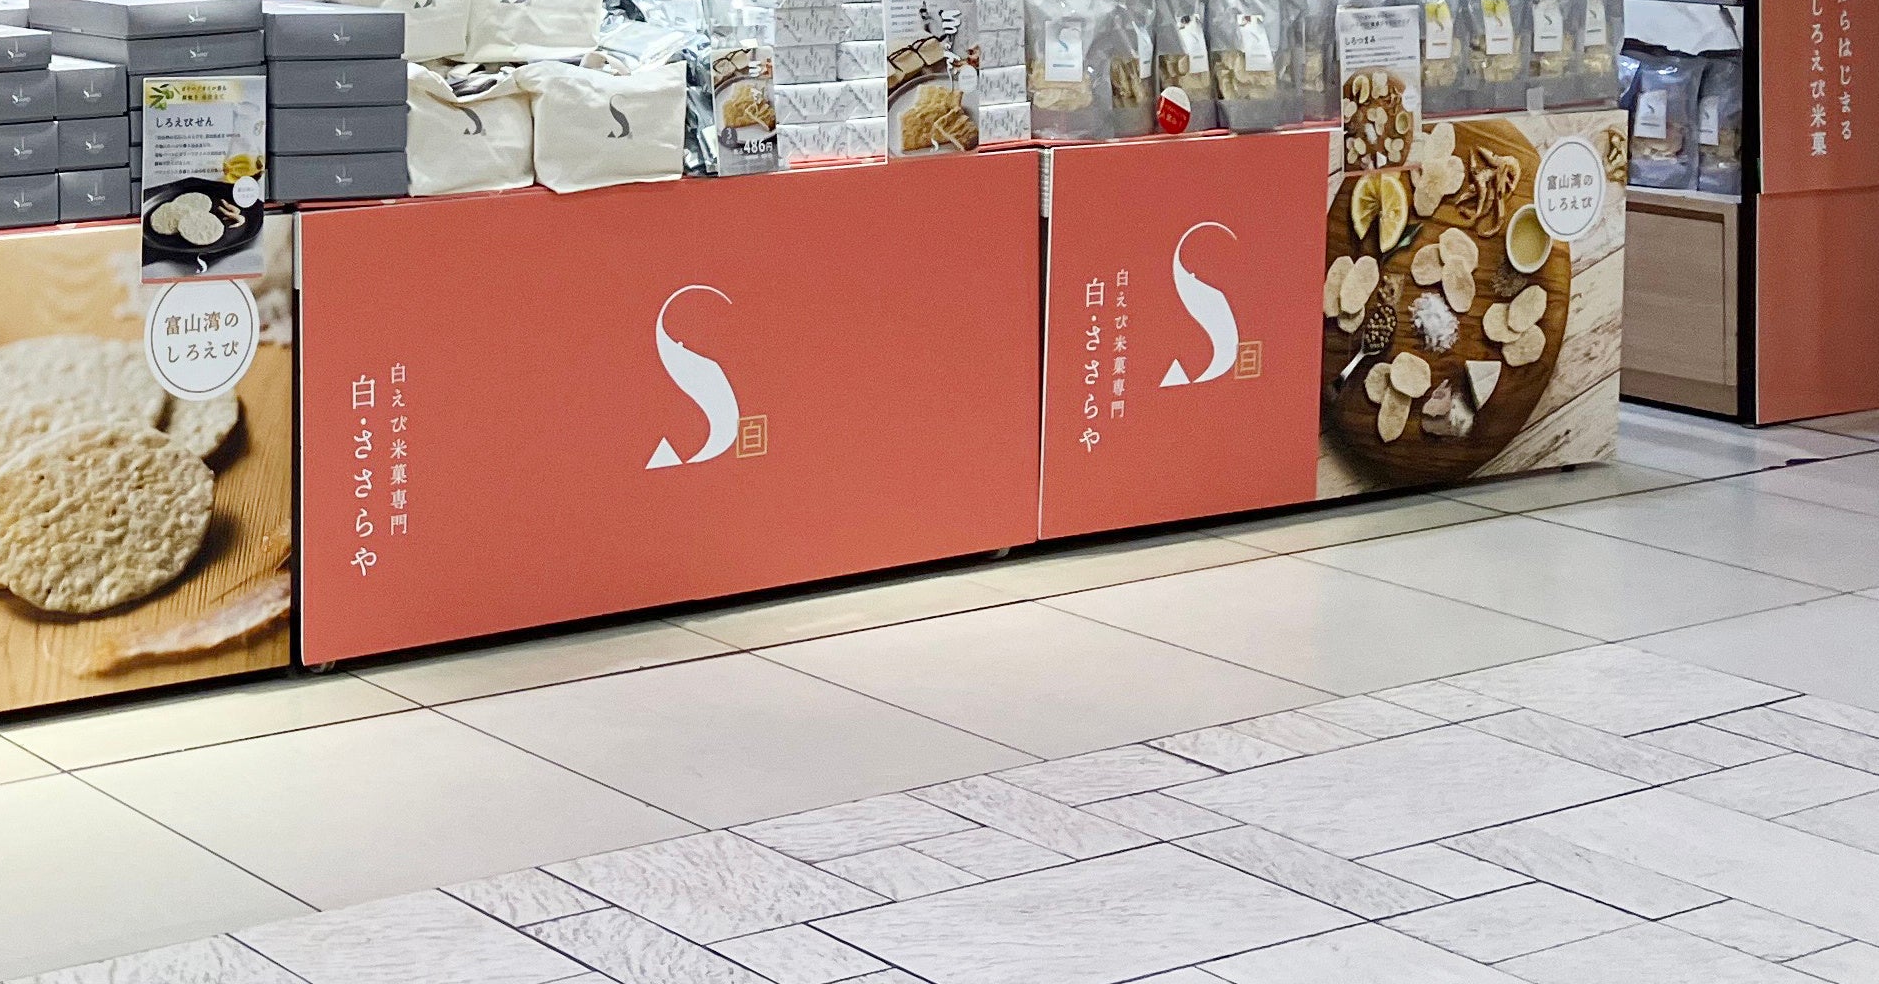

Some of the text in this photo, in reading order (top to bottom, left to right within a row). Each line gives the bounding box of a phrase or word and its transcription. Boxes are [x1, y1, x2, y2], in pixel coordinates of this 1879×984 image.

[1546, 173, 1594, 191] 富山湾の
[1548, 196, 1594, 212] しろえび
[164, 310, 240, 337] 富山湾の
[167, 339, 240, 364] しろえび
[1109, 267, 1130, 419] 白えび米菓専門
[389, 361, 408, 536] 白えび米菓専門
